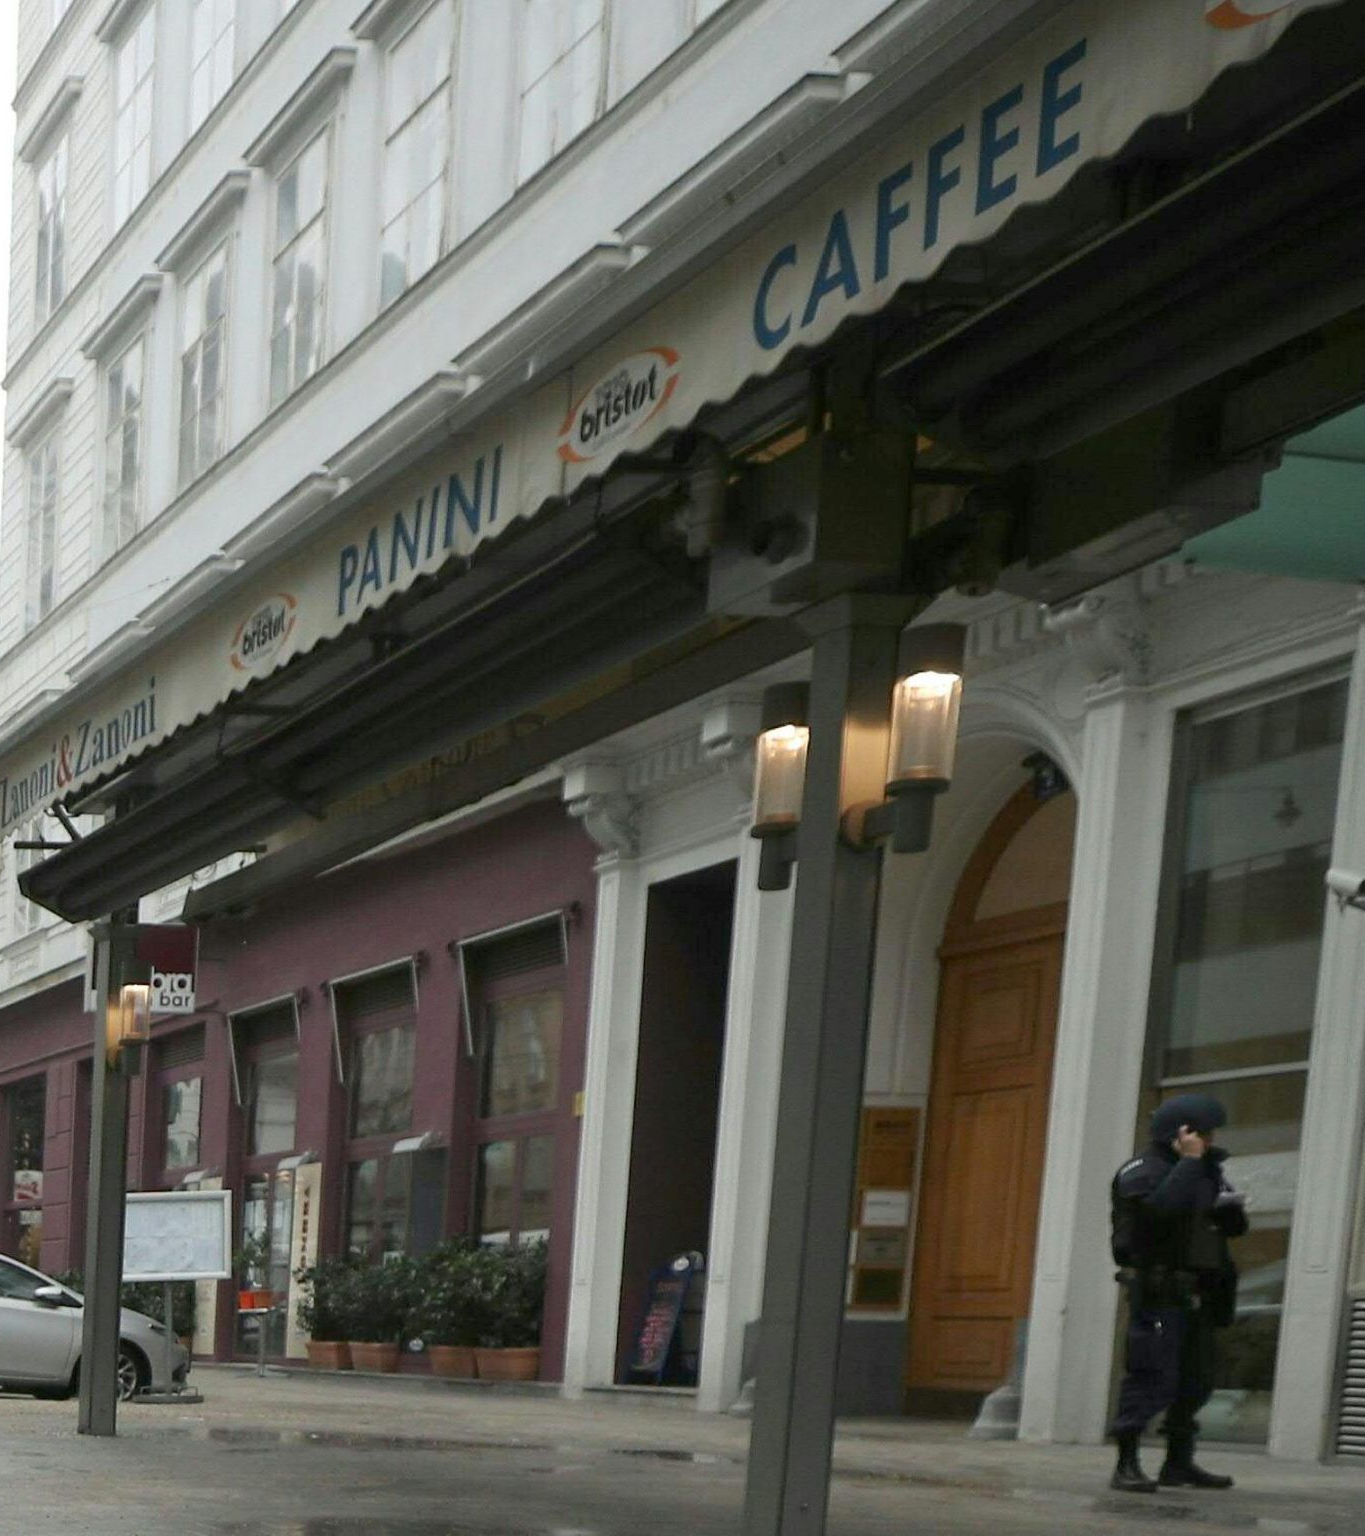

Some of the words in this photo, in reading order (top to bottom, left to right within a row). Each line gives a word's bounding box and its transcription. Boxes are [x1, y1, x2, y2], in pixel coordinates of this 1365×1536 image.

[752, 37, 1087, 350] CAFFEE
[580, 361, 658, 442] bristot
[338, 443, 503, 617] PANINI
